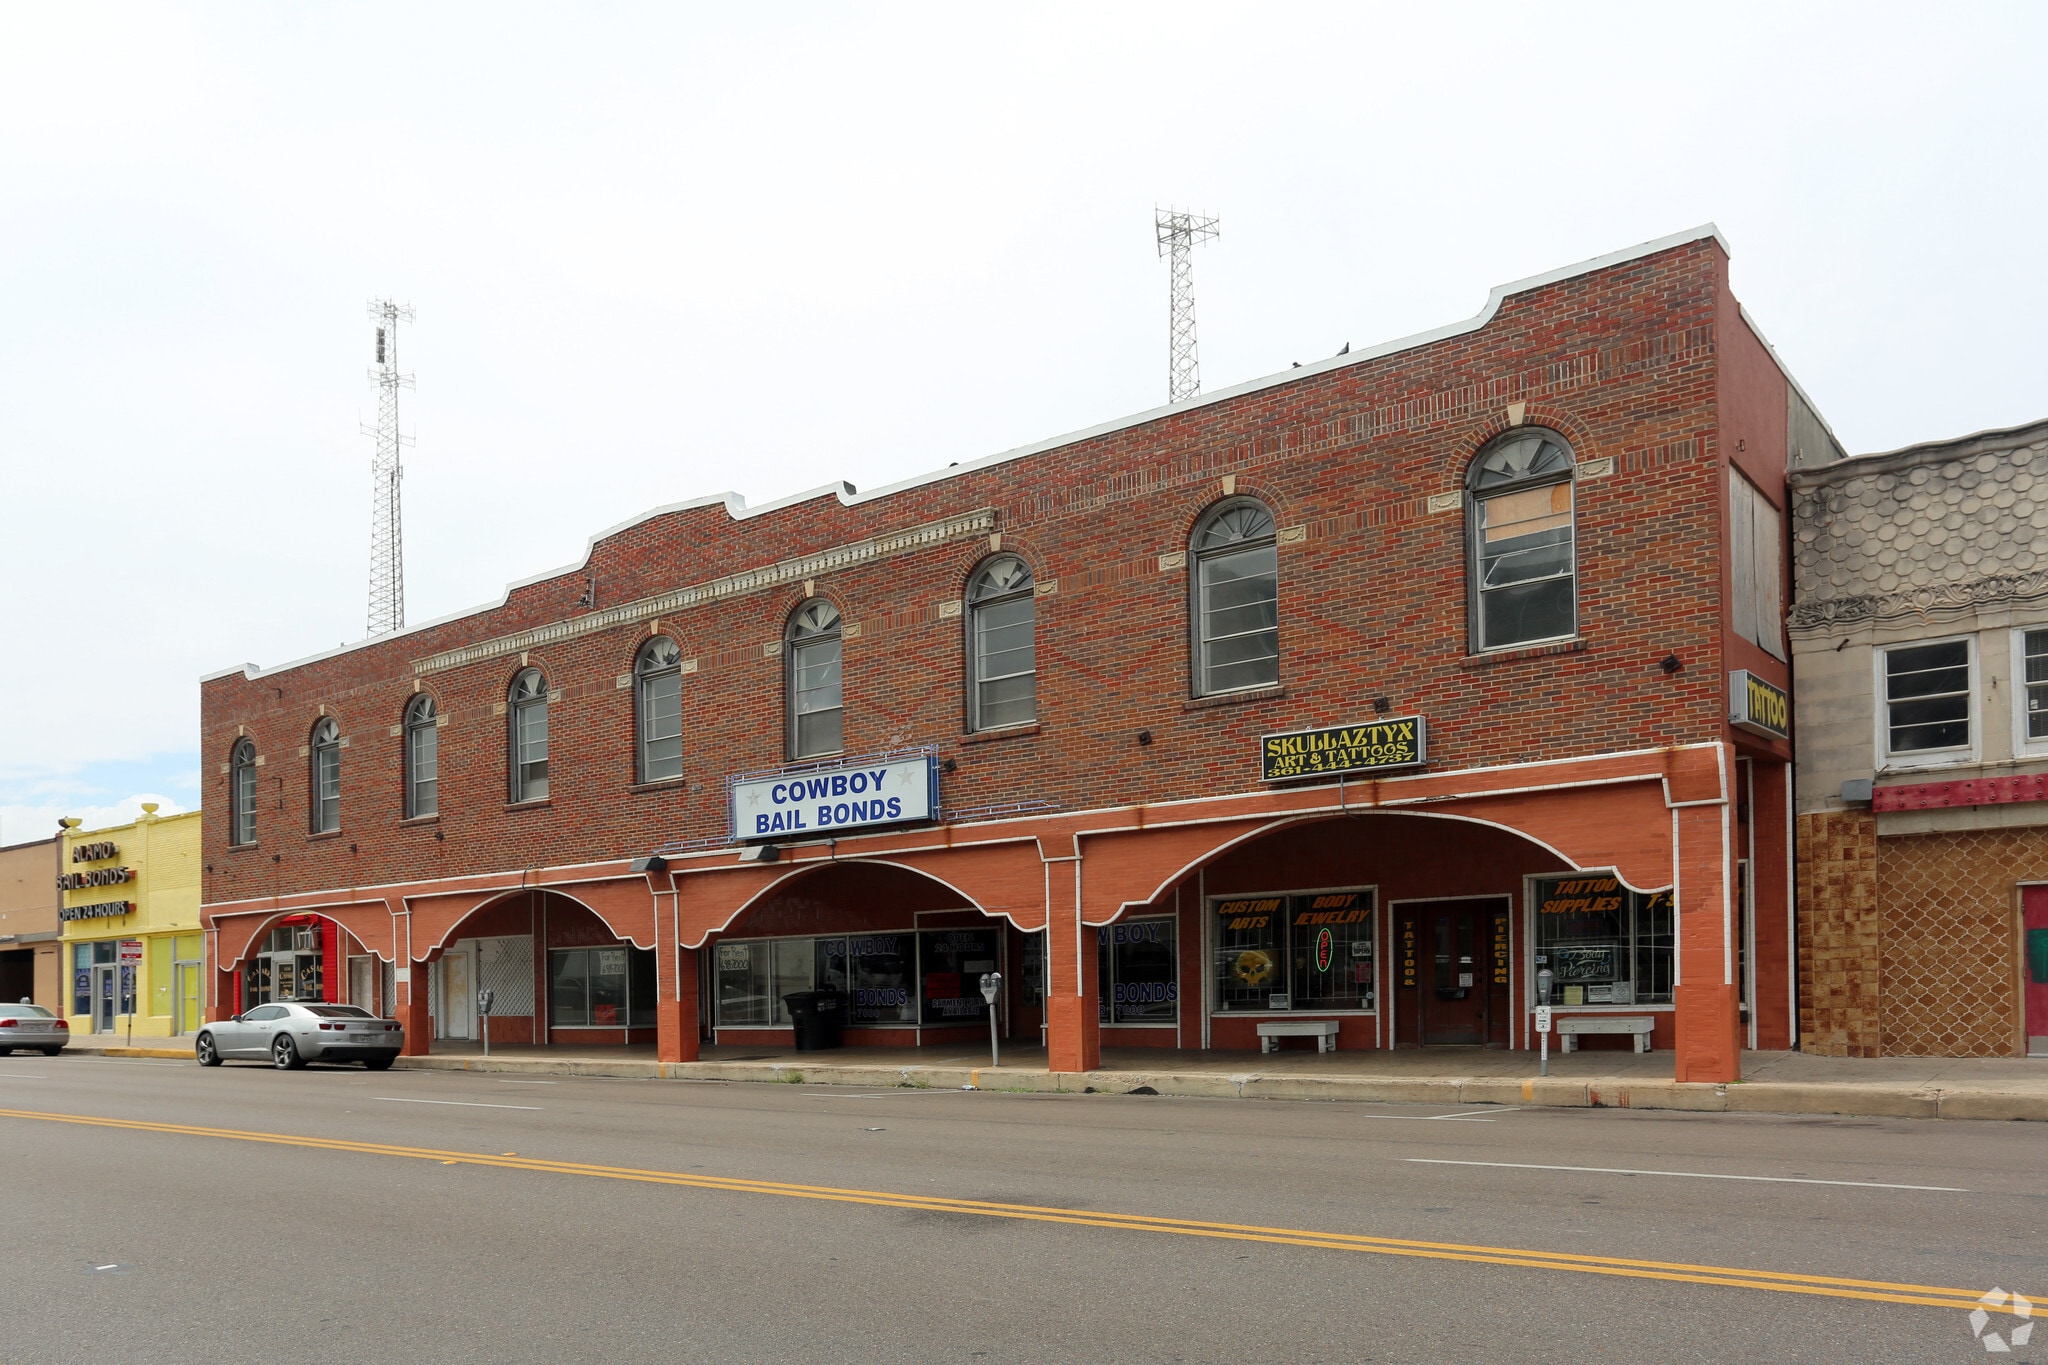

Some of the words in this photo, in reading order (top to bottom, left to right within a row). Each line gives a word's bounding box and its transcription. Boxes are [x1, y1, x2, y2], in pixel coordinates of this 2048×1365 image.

[1747, 676, 1787, 729] TATTOO
[1267, 721, 1414, 757] SKULLAZTYX
[1267, 751, 1415, 778] 361-444-4737
[1274, 754, 1307, 769] ART
[1309, 752, 1322, 765] &
[1326, 741, 1409, 763] TATTOOS
[771, 769, 887, 804] COWBOY
[756, 809, 807, 834] BAIL
[818, 796, 902, 826] BONDS
[73, 842, 114, 863] ALAMO
[57, 873, 84, 891] BAIL
[85, 867, 127, 888] BONDS
[1553, 878, 1620, 896] TATTOO
[59, 907, 81, 921] OPEN
[82, 905, 93, 918] 24
[94, 901, 125, 917] HOURS
[1218, 898, 1282, 915] CUSTOM
[1312, 894, 1357, 909] BODY
[1540, 896, 1622, 914] SUPPLIES
[1228, 916, 1270, 930] ARTS
[1293, 909, 1371, 926] JEWELRY
[824, 936, 898, 957] COWBOY
[945, 932, 974, 943] OPEN
[950, 942, 984, 952] HOURS
[1404, 921, 1415, 976] TATTOO
[1494, 918, 1507, 983] PIERCING
[1559, 960, 1610, 978] Piercing
[856, 988, 907, 1006] BONDS
[966, 997, 987, 1007] PLAN
[1113, 982, 1177, 1002] BONDS
